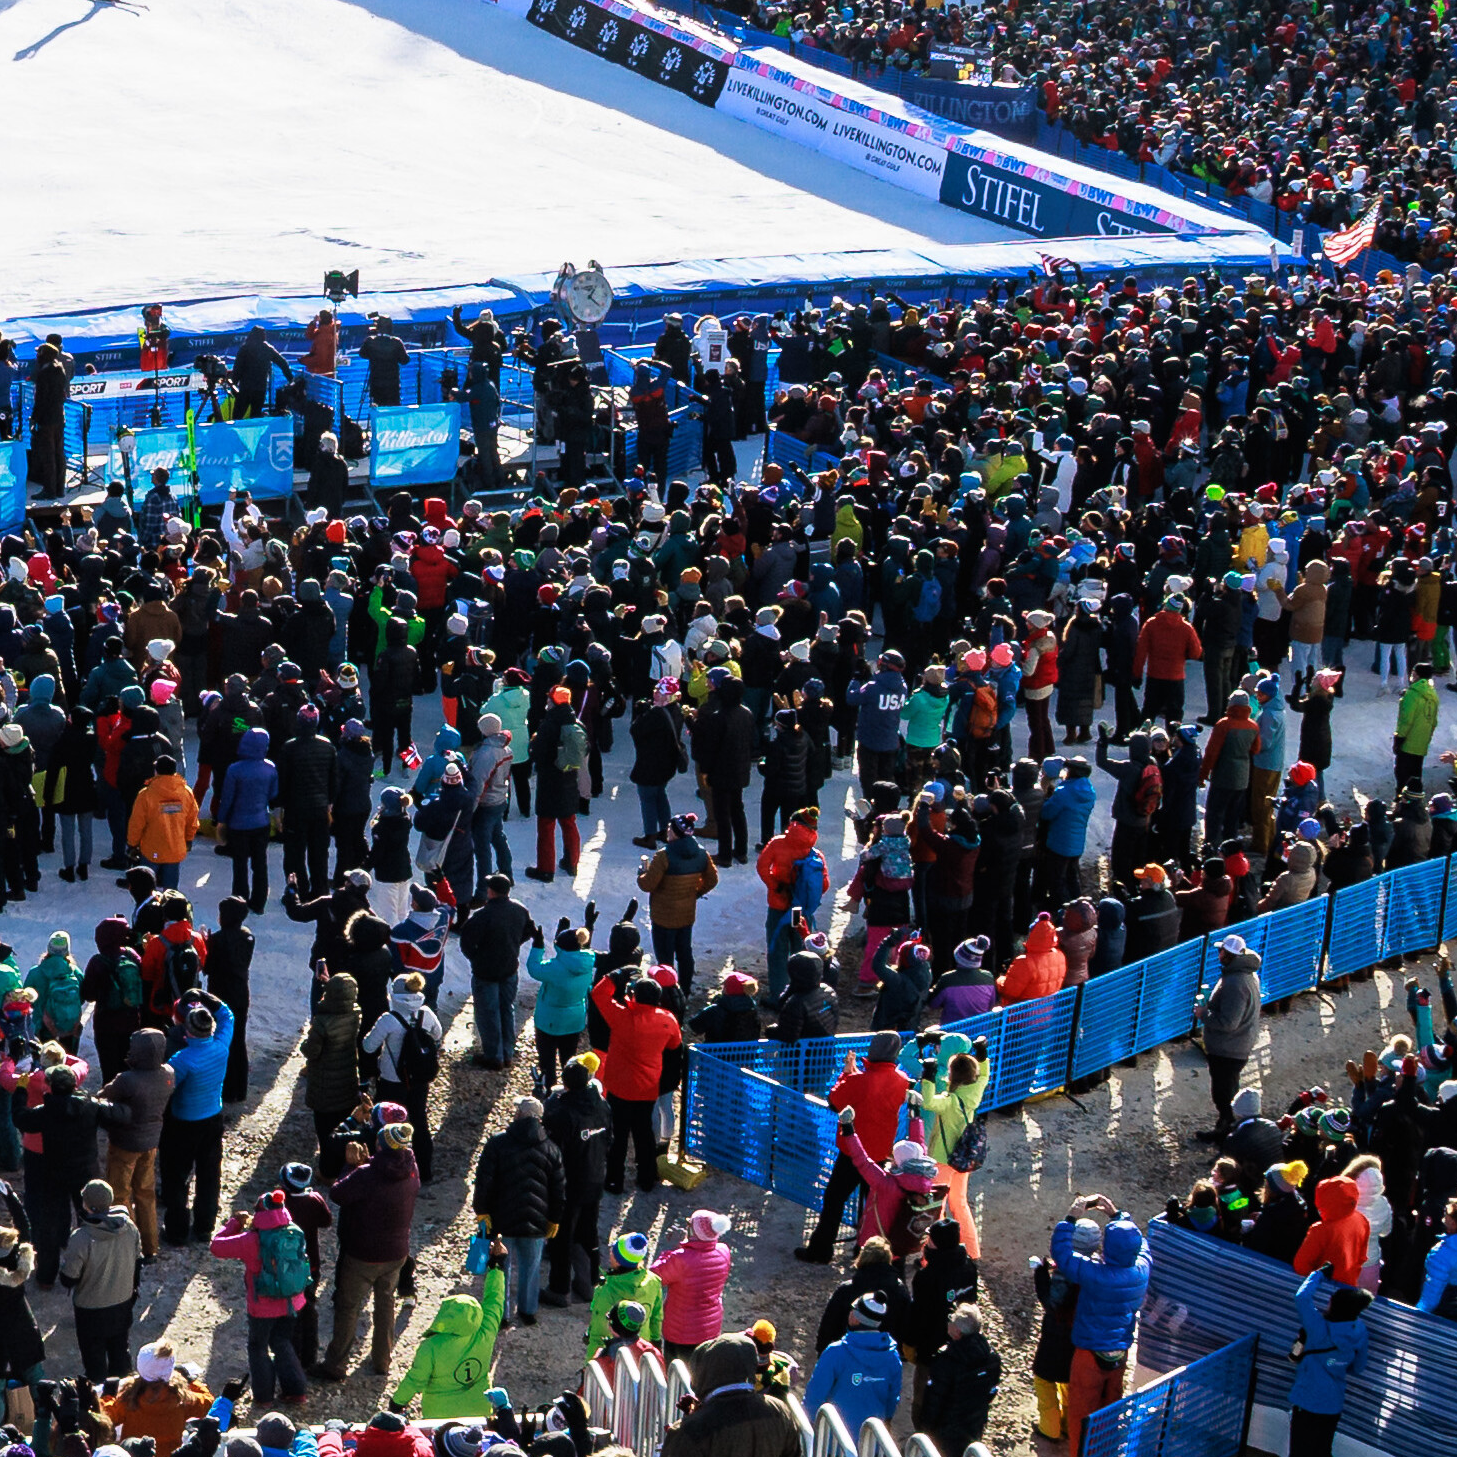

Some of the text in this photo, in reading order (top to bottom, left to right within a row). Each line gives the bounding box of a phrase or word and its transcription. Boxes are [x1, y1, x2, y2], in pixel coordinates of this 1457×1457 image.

[741, 54, 761, 74] BWT
[773, 66, 794, 88] BWT
[727, 79, 828, 132] LIVEKILLINGTON.COM
[848, 96, 871, 119] BWT
[887, 111, 909, 134] BWT
[832, 122, 942, 176] LIVEKILLINGTON.COM
[960, 140, 986, 162] BWT
[1001, 157, 1027, 177] BWT
[961, 164, 1045, 233] STIFEL
[1086, 185, 1116, 207] BWT
[1132, 199, 1160, 223] BWT
[95, 352, 123, 361] STIFEL
[878, 693, 906, 711] USA
